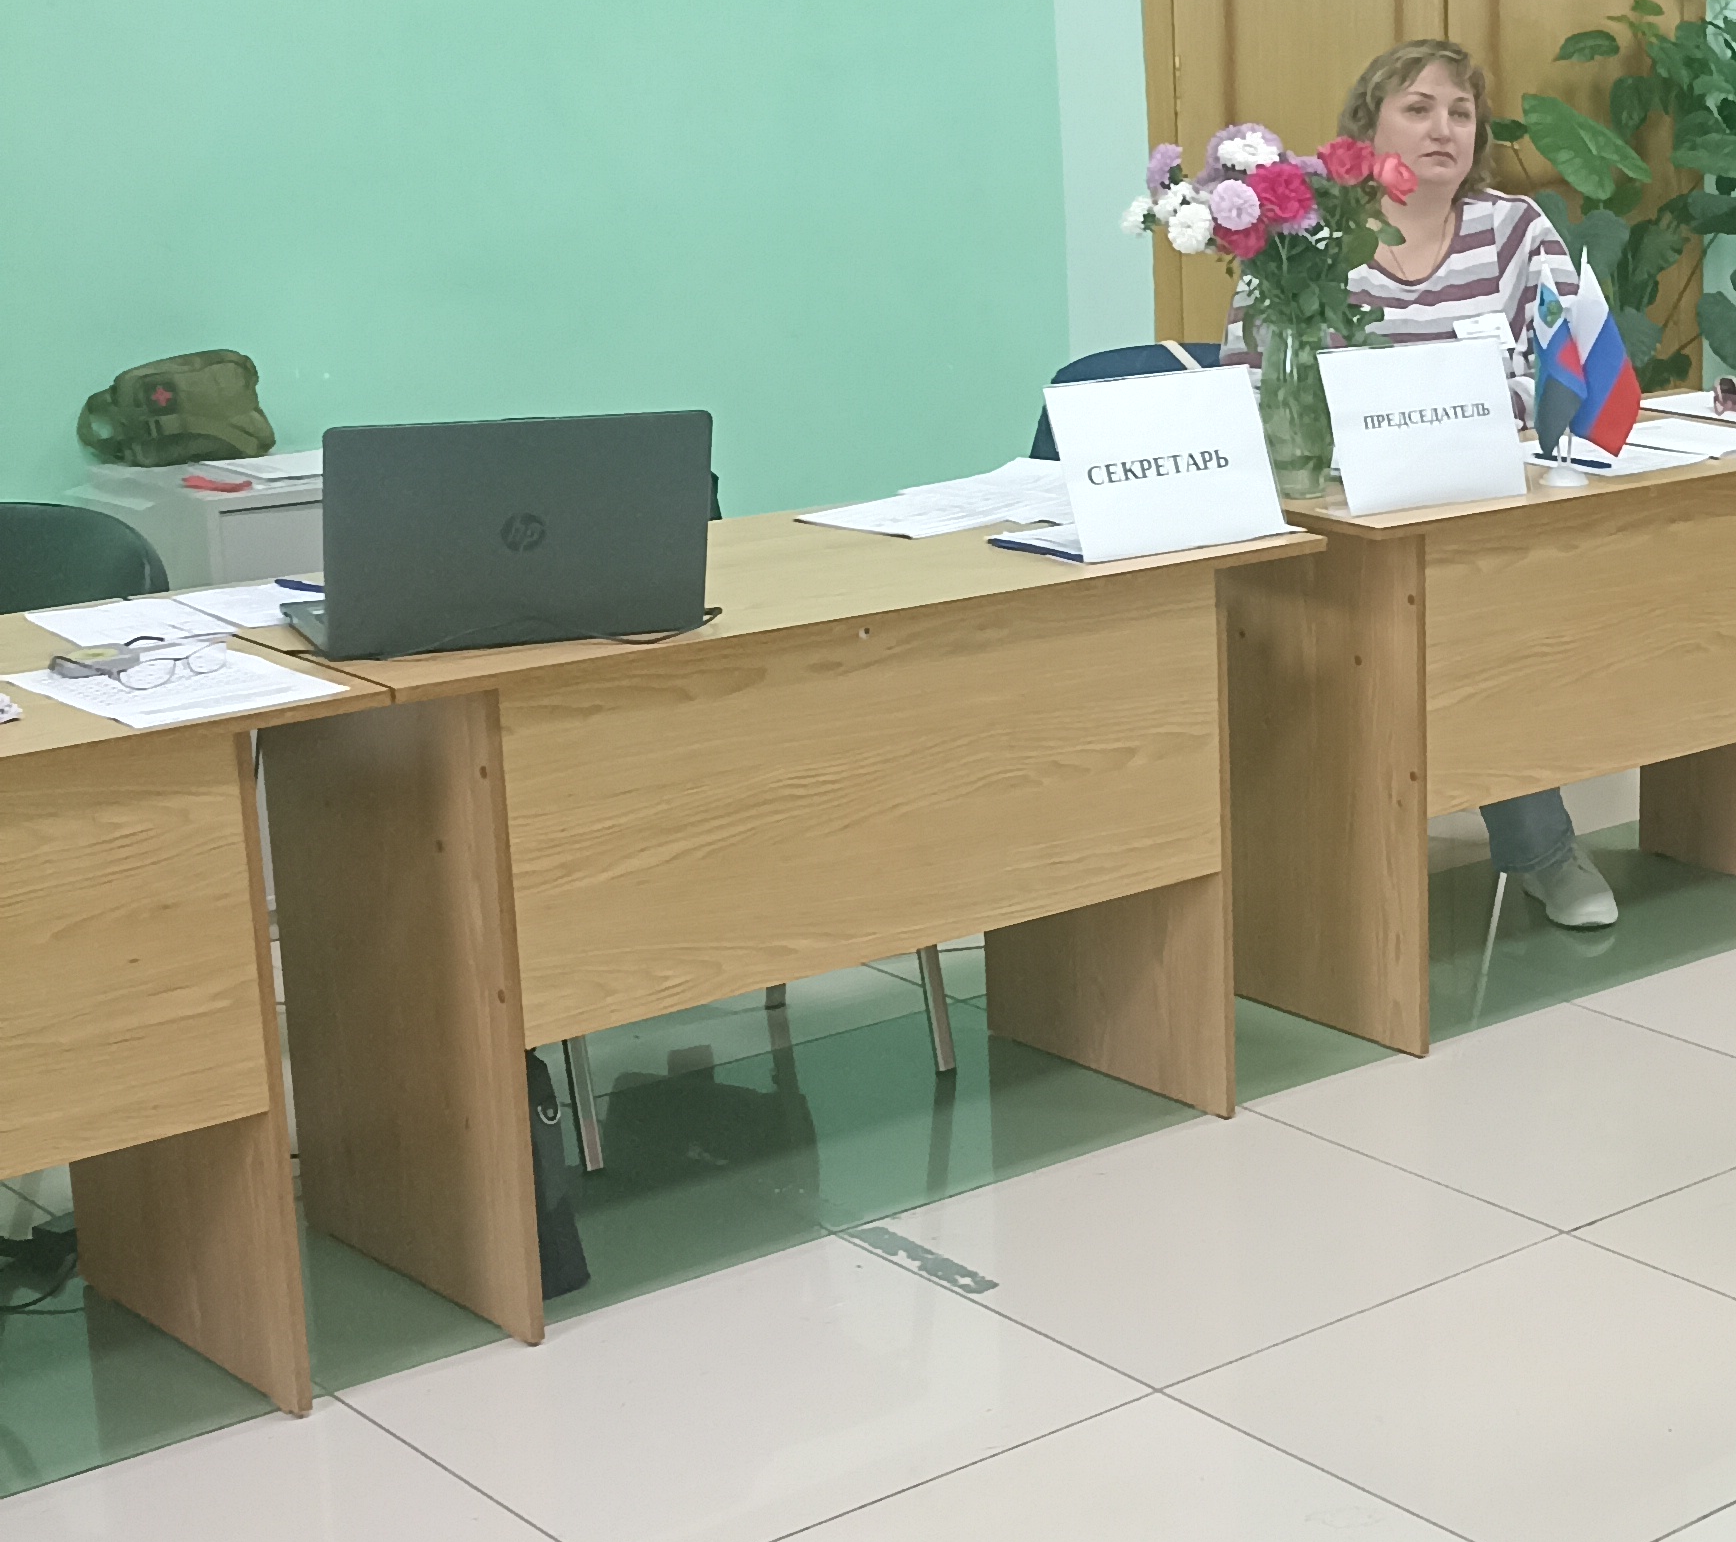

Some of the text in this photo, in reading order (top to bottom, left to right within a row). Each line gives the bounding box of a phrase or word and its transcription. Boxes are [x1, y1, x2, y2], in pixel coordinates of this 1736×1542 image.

[1363, 402, 1491, 429] ПРЕДСЕДАТЕЛЬ
[1087, 449, 1230, 486] СЕКРЕТАРЬ
[503, 512, 546, 551] hp
